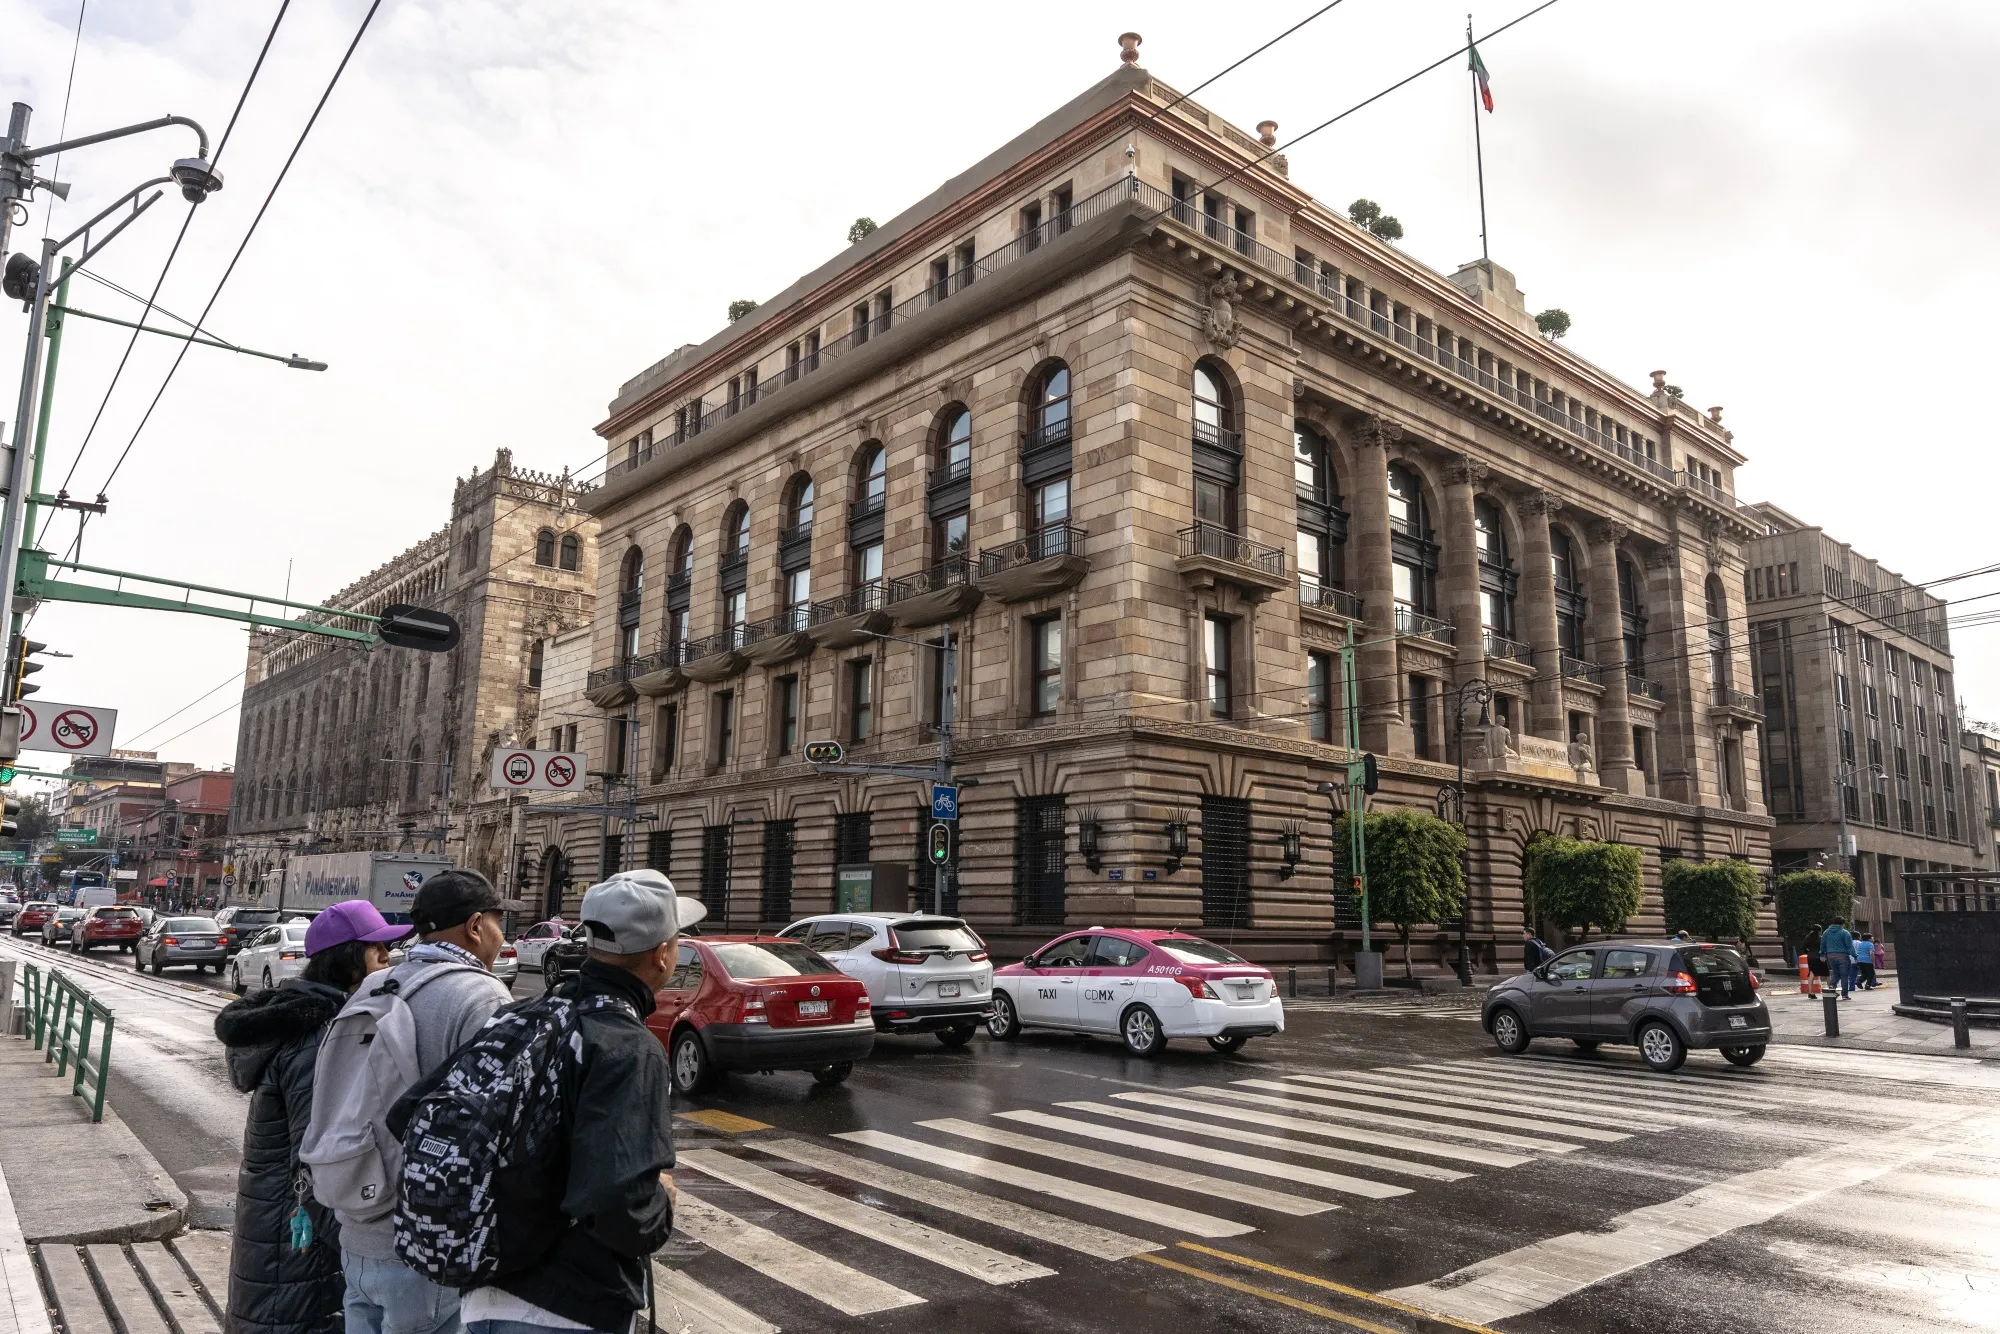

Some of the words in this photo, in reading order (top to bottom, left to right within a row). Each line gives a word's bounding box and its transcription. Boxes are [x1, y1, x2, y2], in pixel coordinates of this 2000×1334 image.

[1147, 965, 1183, 975] A5010G
[1038, 989, 1057, 999] TAXI
[1084, 989, 1114, 1001] CDMX
[420, 1140, 447, 1156] PUMA
